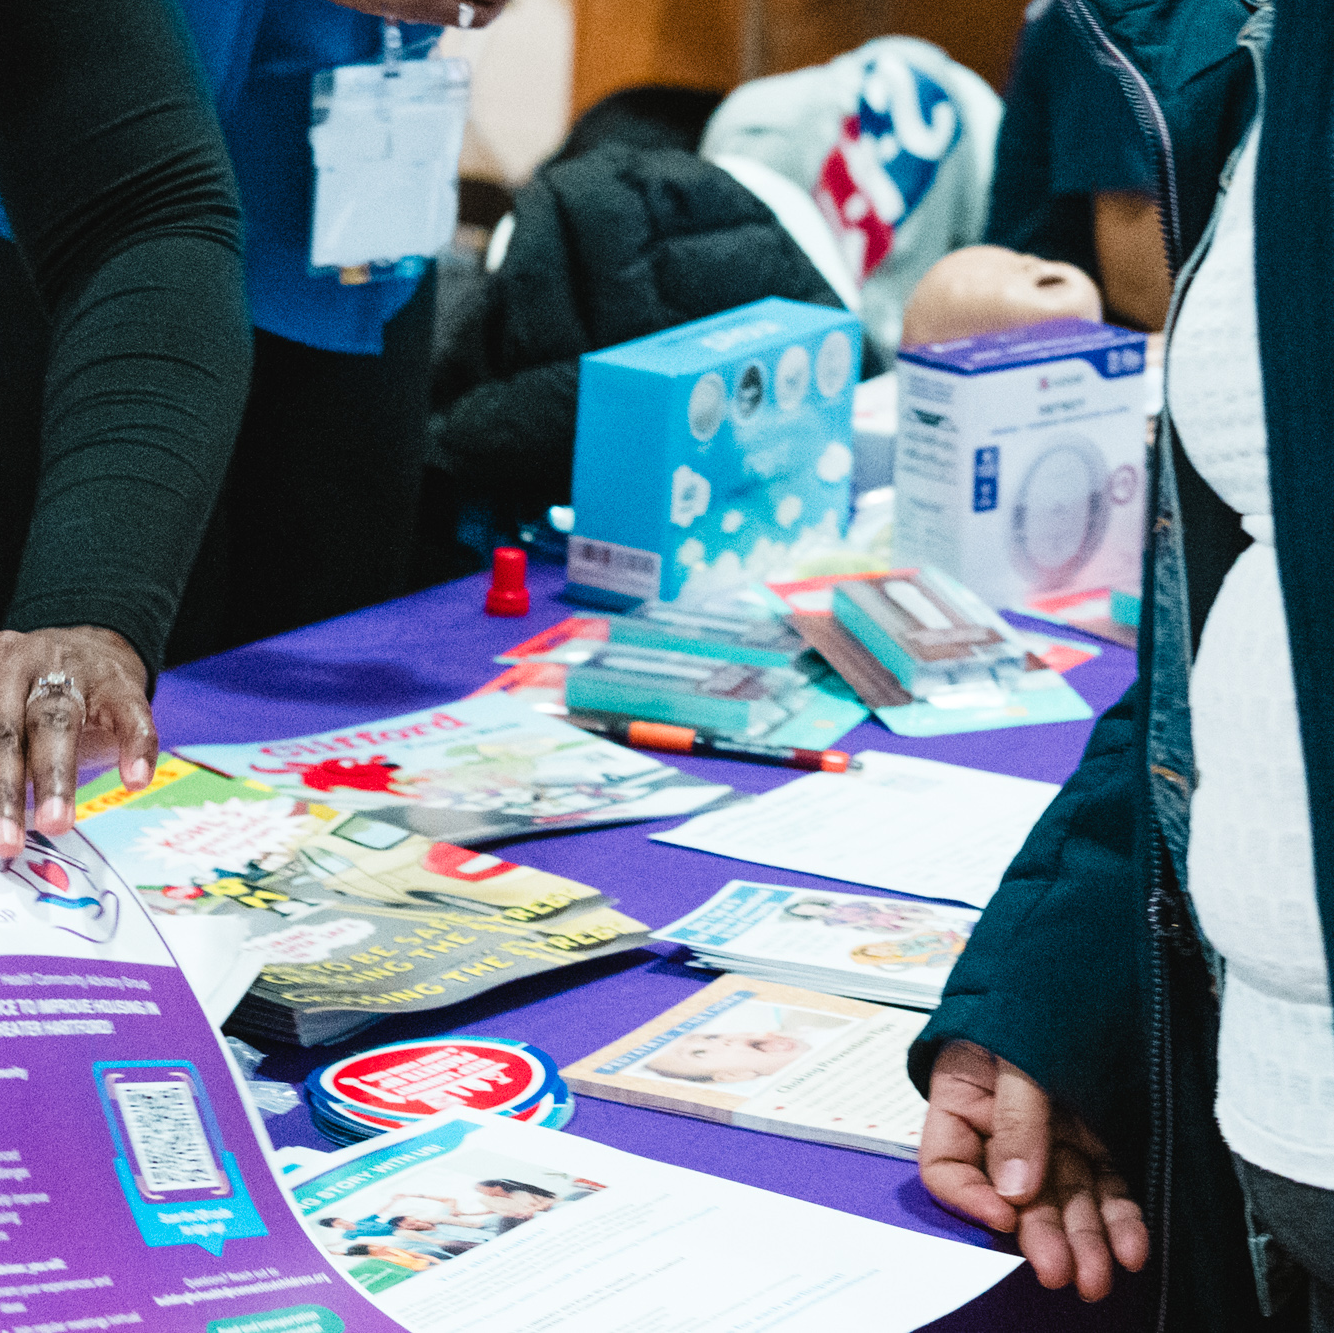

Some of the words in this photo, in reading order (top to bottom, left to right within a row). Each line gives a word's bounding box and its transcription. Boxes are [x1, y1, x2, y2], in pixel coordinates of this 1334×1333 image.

[261, 710, 470, 758] Clifford
[351, 945, 397, 965] BE
[411, 933, 477, 960] THE
[443, 955, 514, 984] THE
[17, 998, 39, 1015] TO
[323, 1168, 374, 1200] STORY
[371, 1152, 413, 1177] WITH
